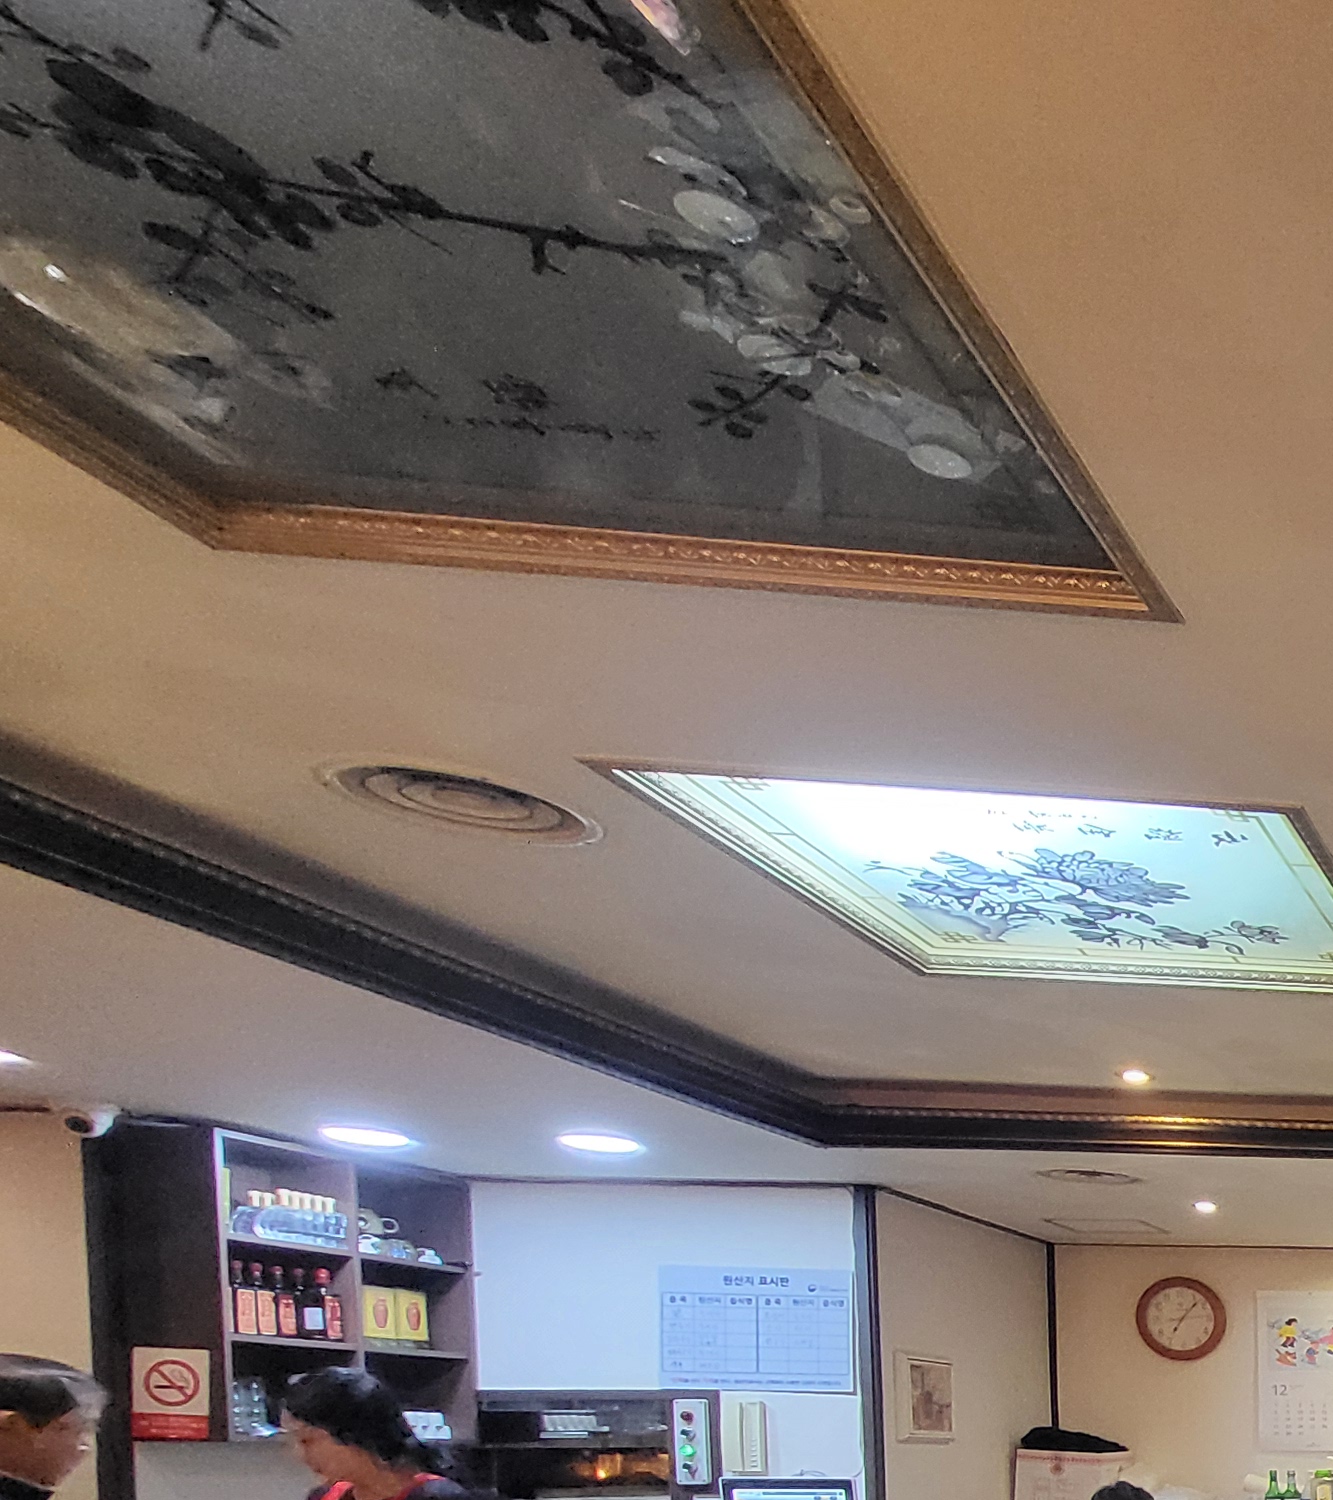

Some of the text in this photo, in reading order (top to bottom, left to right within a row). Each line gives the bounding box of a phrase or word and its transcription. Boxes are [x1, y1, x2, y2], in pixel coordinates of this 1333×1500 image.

[723, 1275, 790, 1287] 원산지 표시판
[1271, 1384, 1288, 1396] 12
